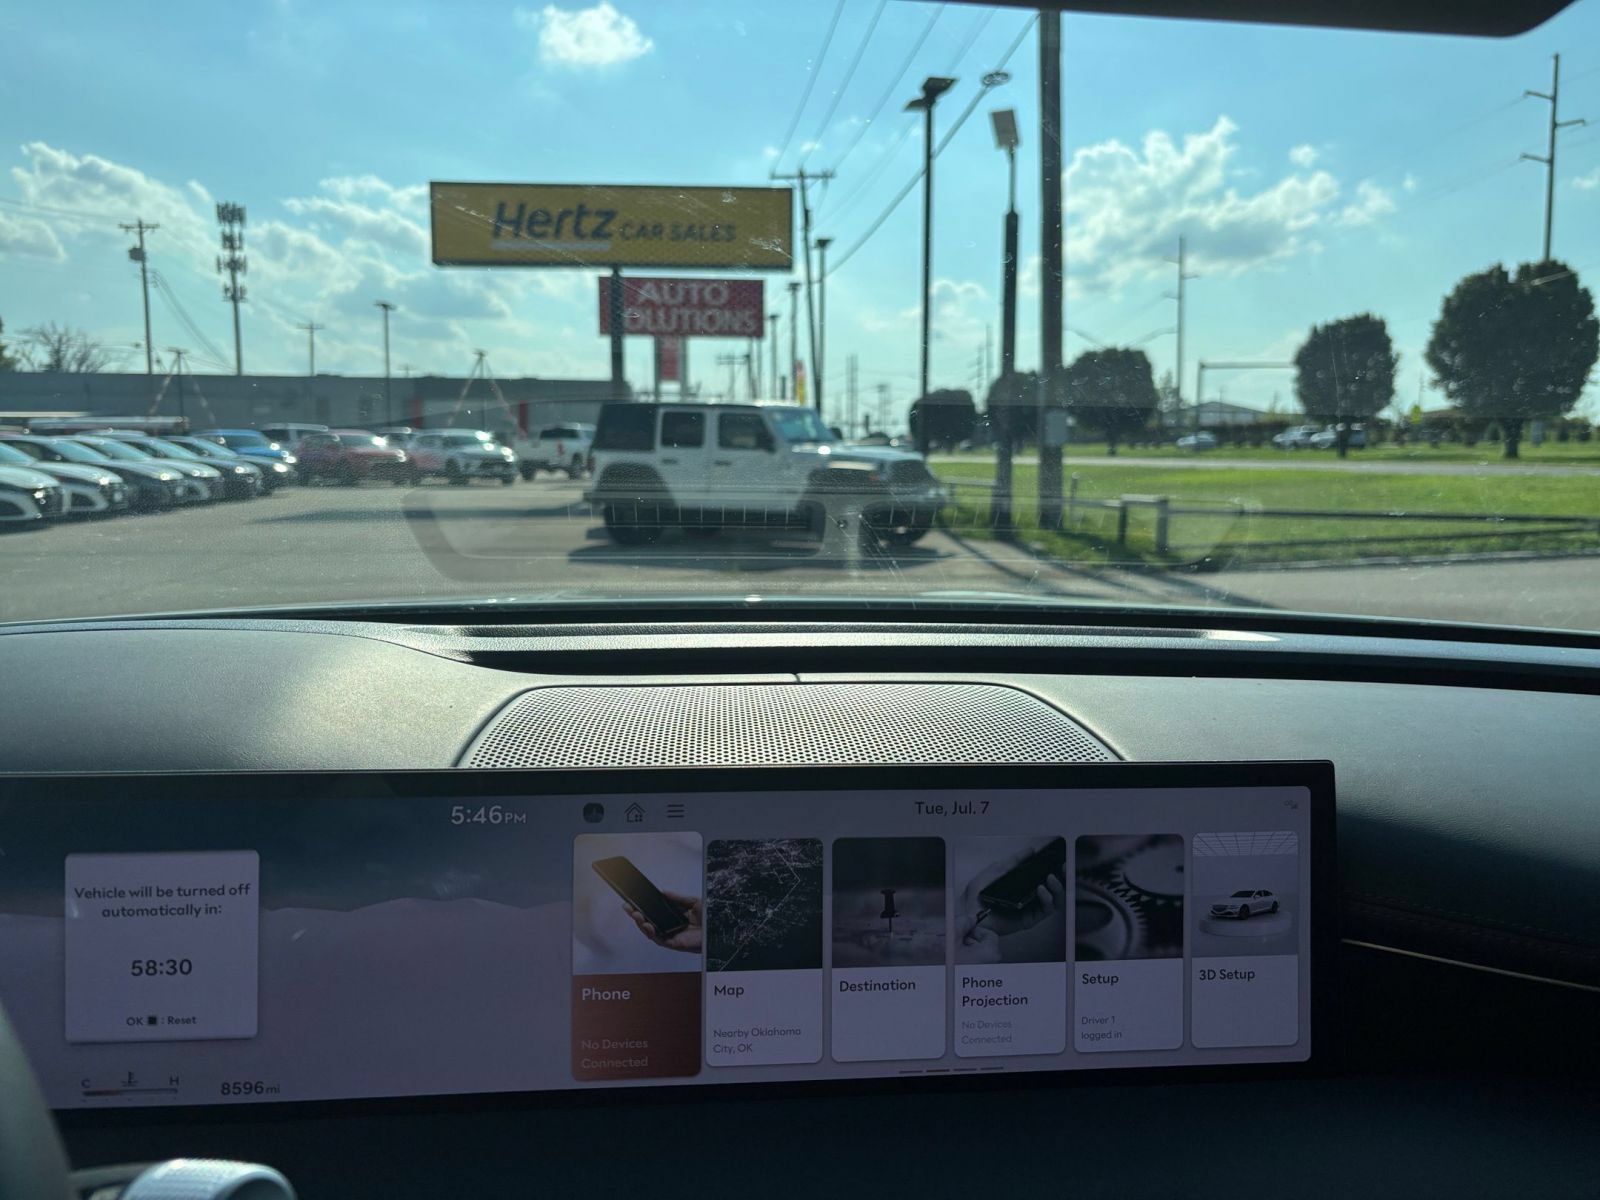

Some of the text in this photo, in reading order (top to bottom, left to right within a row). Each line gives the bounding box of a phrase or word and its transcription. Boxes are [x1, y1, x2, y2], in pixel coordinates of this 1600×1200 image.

[491, 201, 737, 243] Hertz CAR SALES
[637, 282, 728, 305] AUTO
[622, 308, 756, 332] OLUTIONS
[914, 801, 989, 816] Tue, Jul. 7
[74, 883, 250, 898] Vehicle will be turned off
[101, 903, 222, 918] automatically in:
[131, 959, 193, 976] 58:30
[1082, 973, 1119, 986] Setup
[1198, 968, 1255, 983] 3D Setup
[839, 980, 916, 992] Destination
[962, 977, 1003, 988] Phone
[581, 988, 631, 1001] Phone
[713, 985, 745, 998] Map
[962, 995, 1028, 1008] Projection
[126, 1017, 143, 1025] OK
[167, 1016, 197, 1025] Reset
[961, 1020, 1012, 1030] No Devices
[1081, 1016, 1109, 1025] Driver
[713, 1028, 801, 1039] Nearby Oklahoma
[1081, 1031, 1122, 1041] logged in
[581, 1039, 648, 1050] No Devices
[961, 1035, 1012, 1045] Connected
[713, 1044, 753, 1054] City, OK
[581, 1057, 648, 1069] Connected
[81, 1079, 90, 1088] C
[169, 1077, 179, 1086] H
